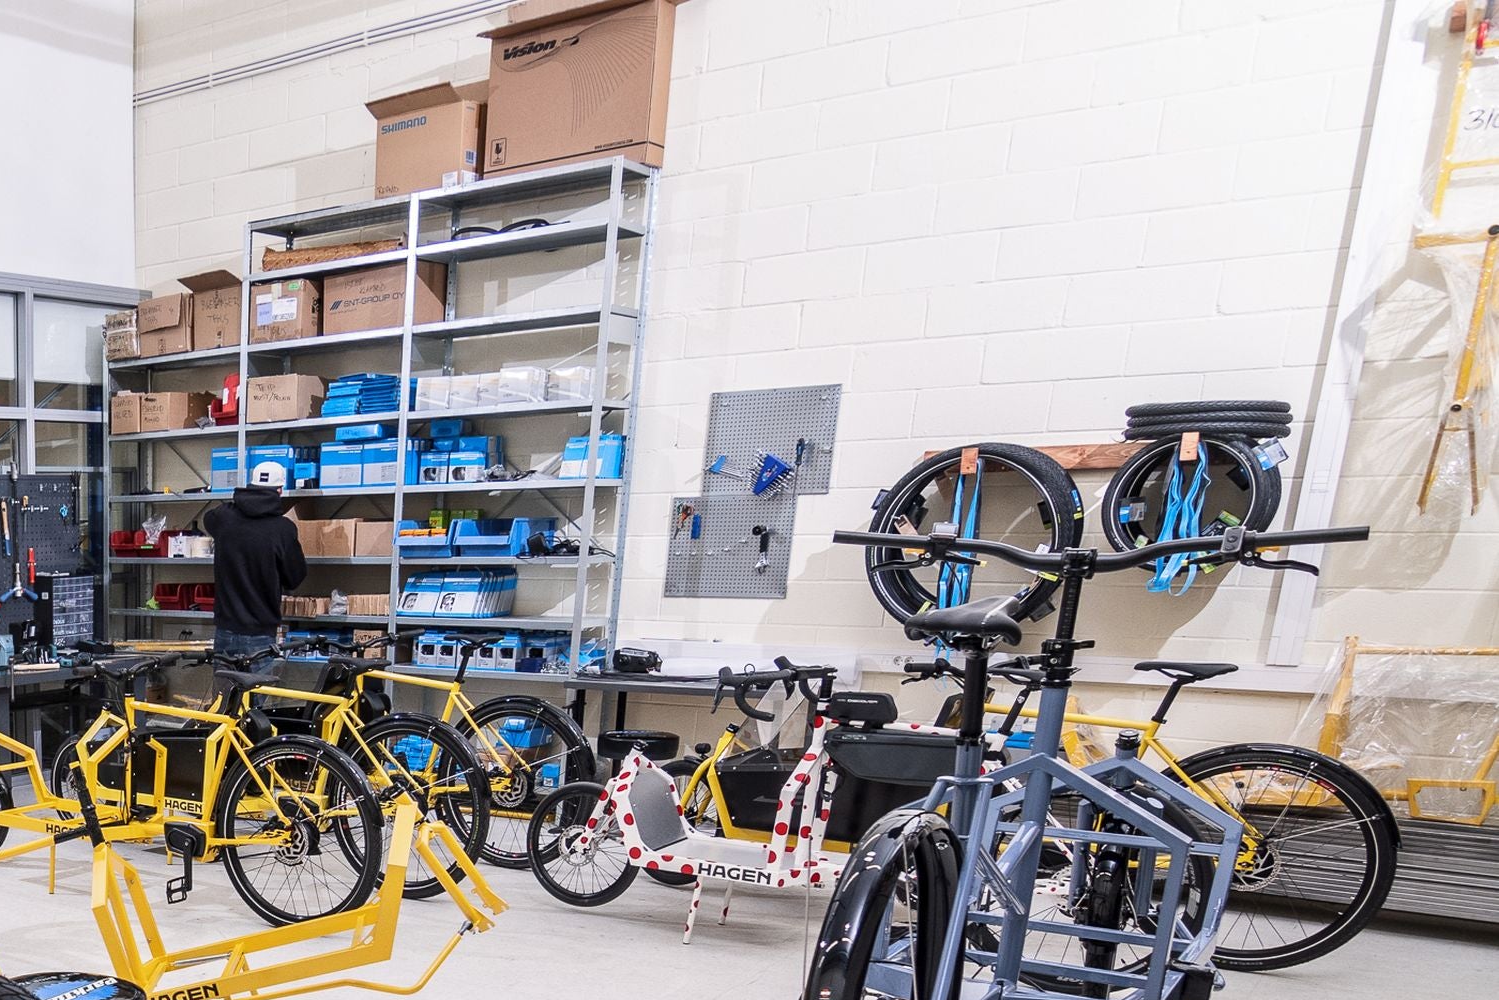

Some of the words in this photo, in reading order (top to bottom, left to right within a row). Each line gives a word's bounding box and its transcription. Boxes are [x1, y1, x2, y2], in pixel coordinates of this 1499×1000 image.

[503, 39, 557, 61] Vision
[381, 115, 427, 135] SHIMANO
[164, 799, 203, 813] HAGEN
[697, 862, 772, 885] HAGEN
